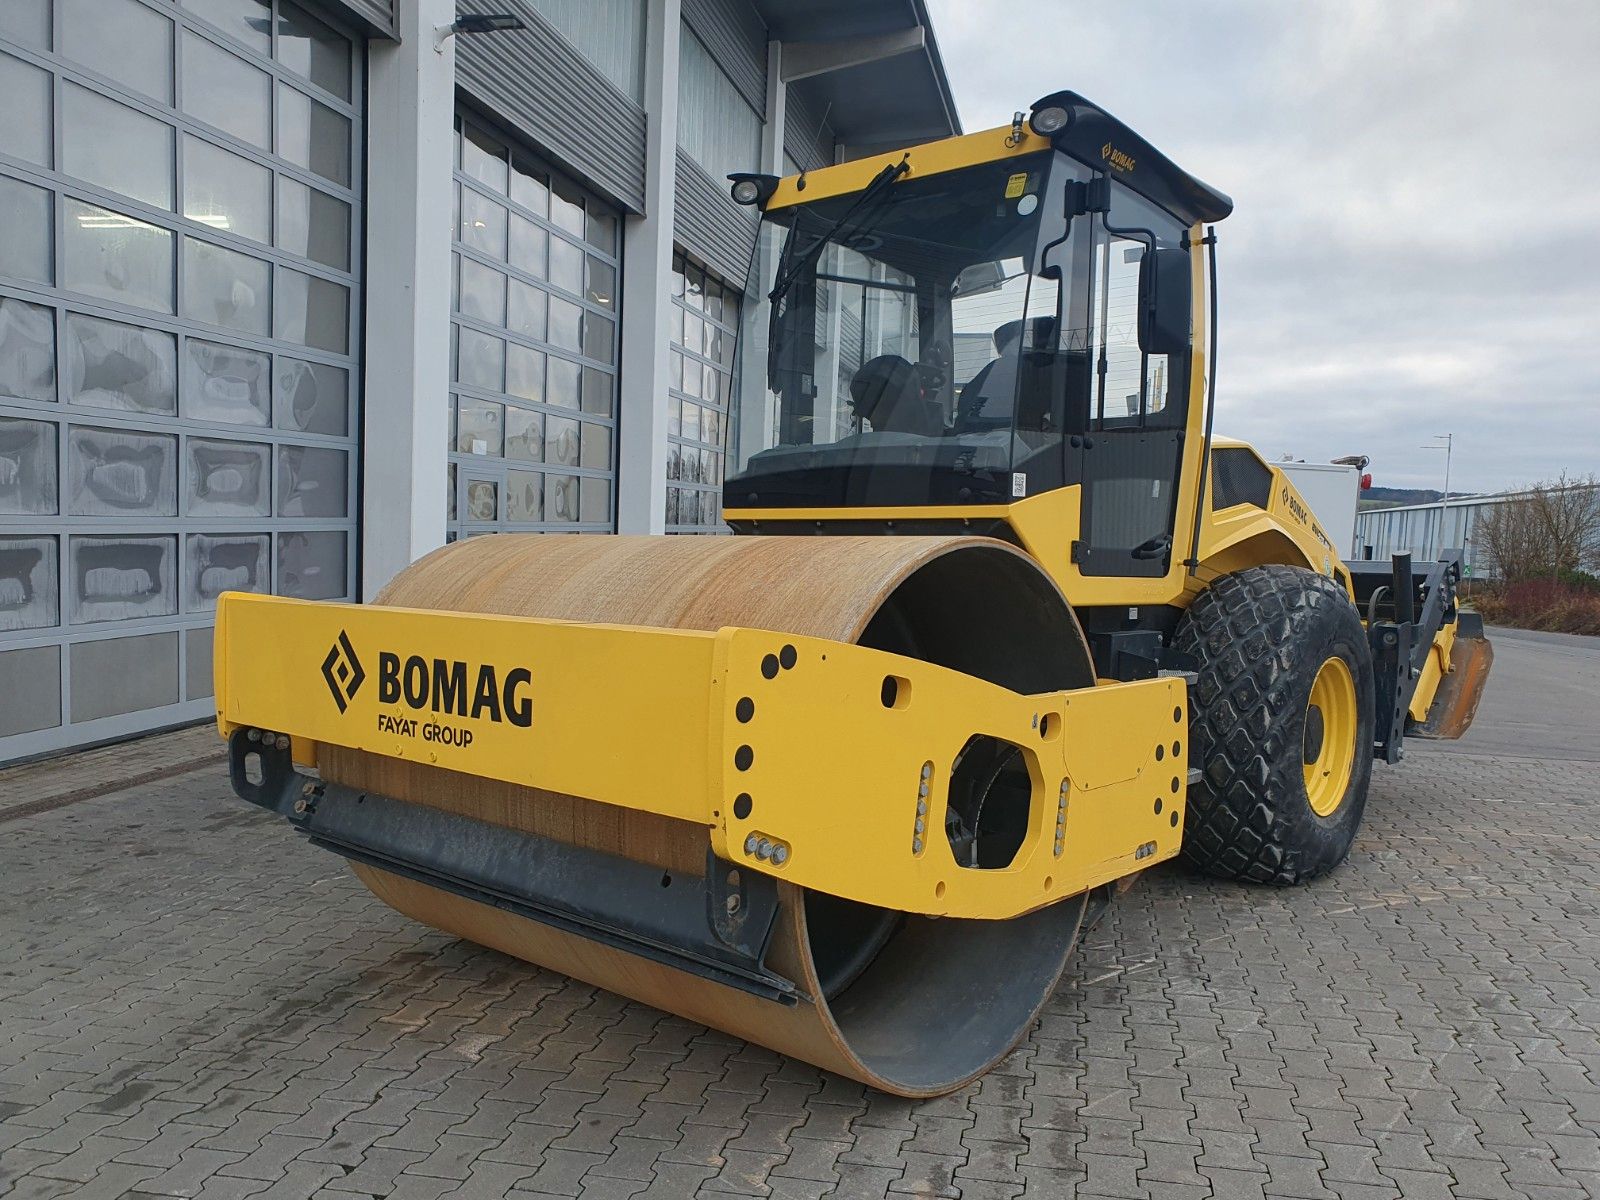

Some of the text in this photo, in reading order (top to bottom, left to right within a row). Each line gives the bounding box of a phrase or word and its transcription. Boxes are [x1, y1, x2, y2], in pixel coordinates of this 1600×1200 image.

[1110, 149, 1136, 171] BOMAG
[378, 651, 533, 728] BOMAG
[378, 714, 473, 748] FAYAT GROUP
